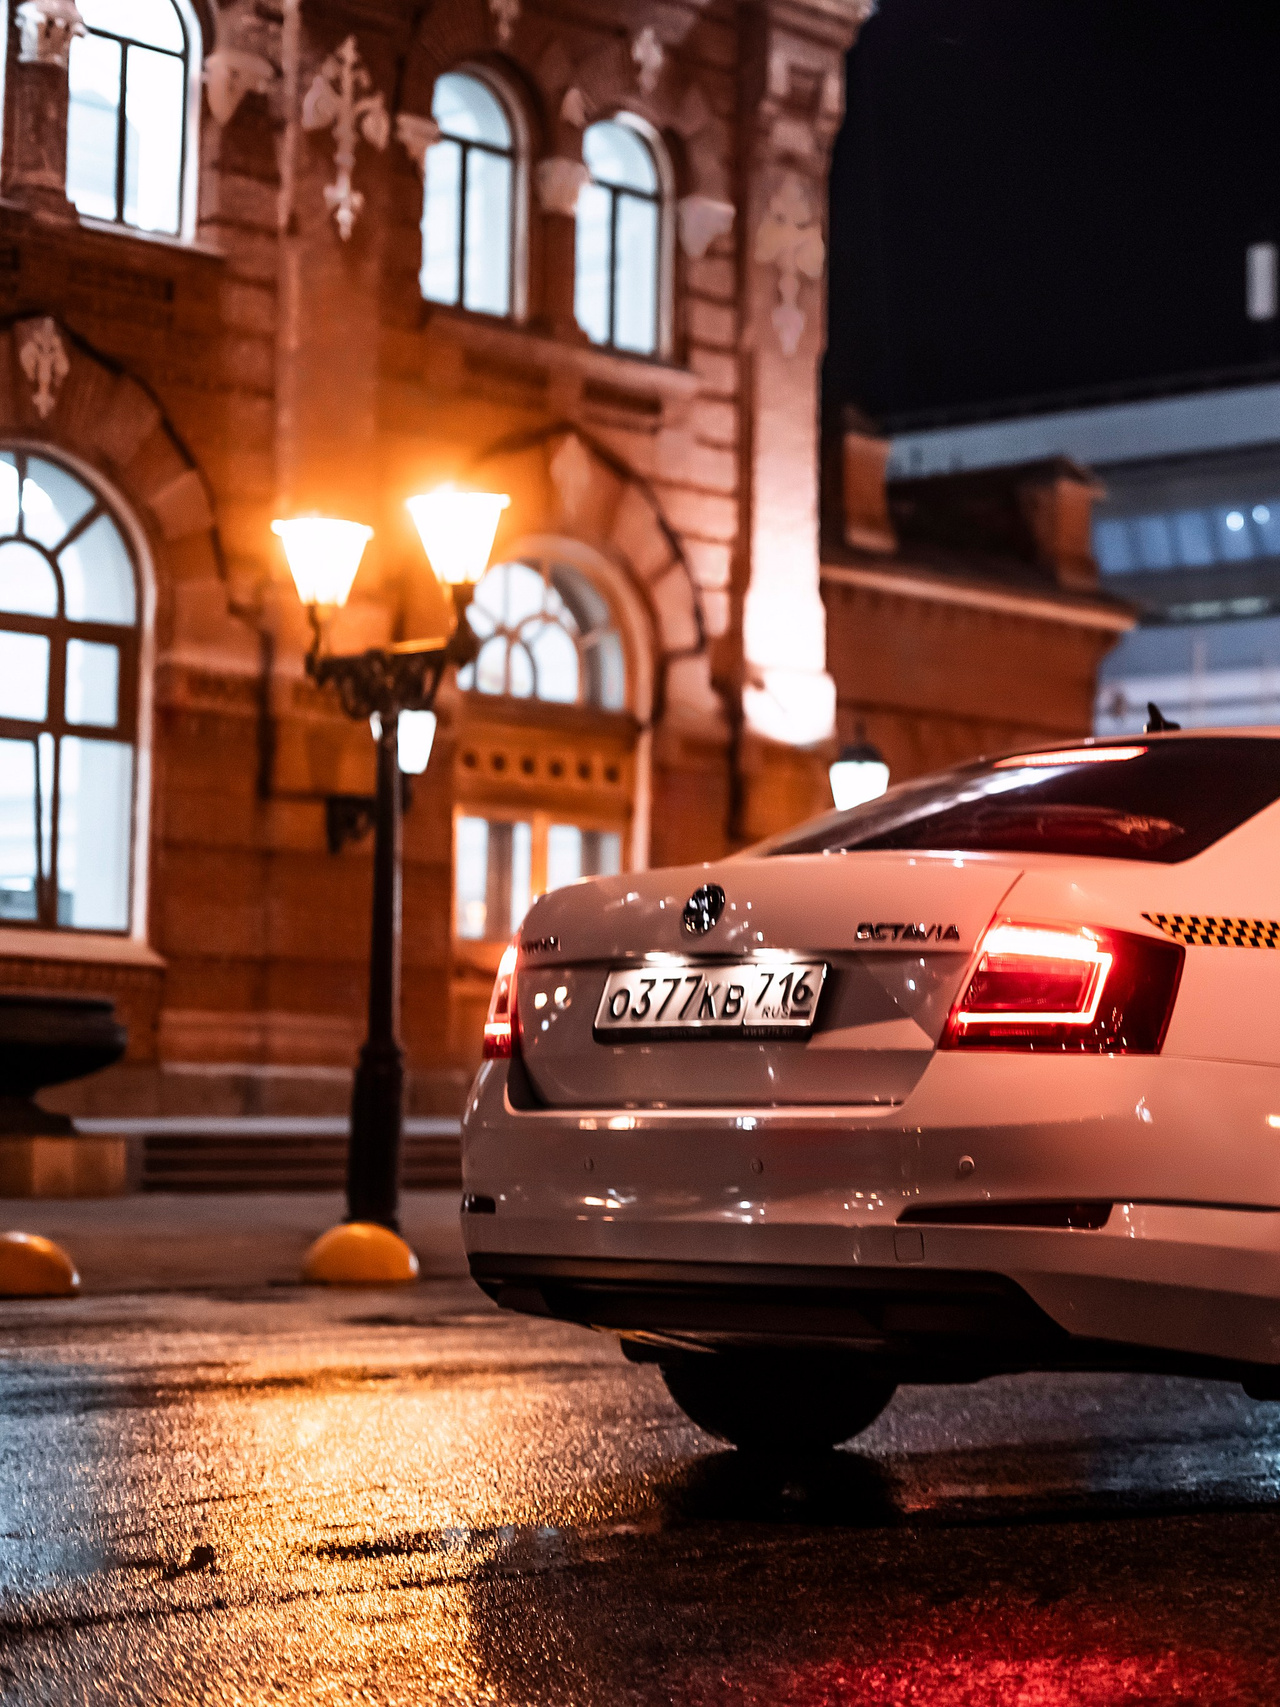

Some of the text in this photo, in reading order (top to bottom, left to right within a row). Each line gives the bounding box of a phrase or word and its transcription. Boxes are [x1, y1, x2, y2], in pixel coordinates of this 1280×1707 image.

[856, 922, 960, 941] OCTAVIA
[755, 971, 814, 1007] 716
[762, 1006, 790, 1019] RUS
